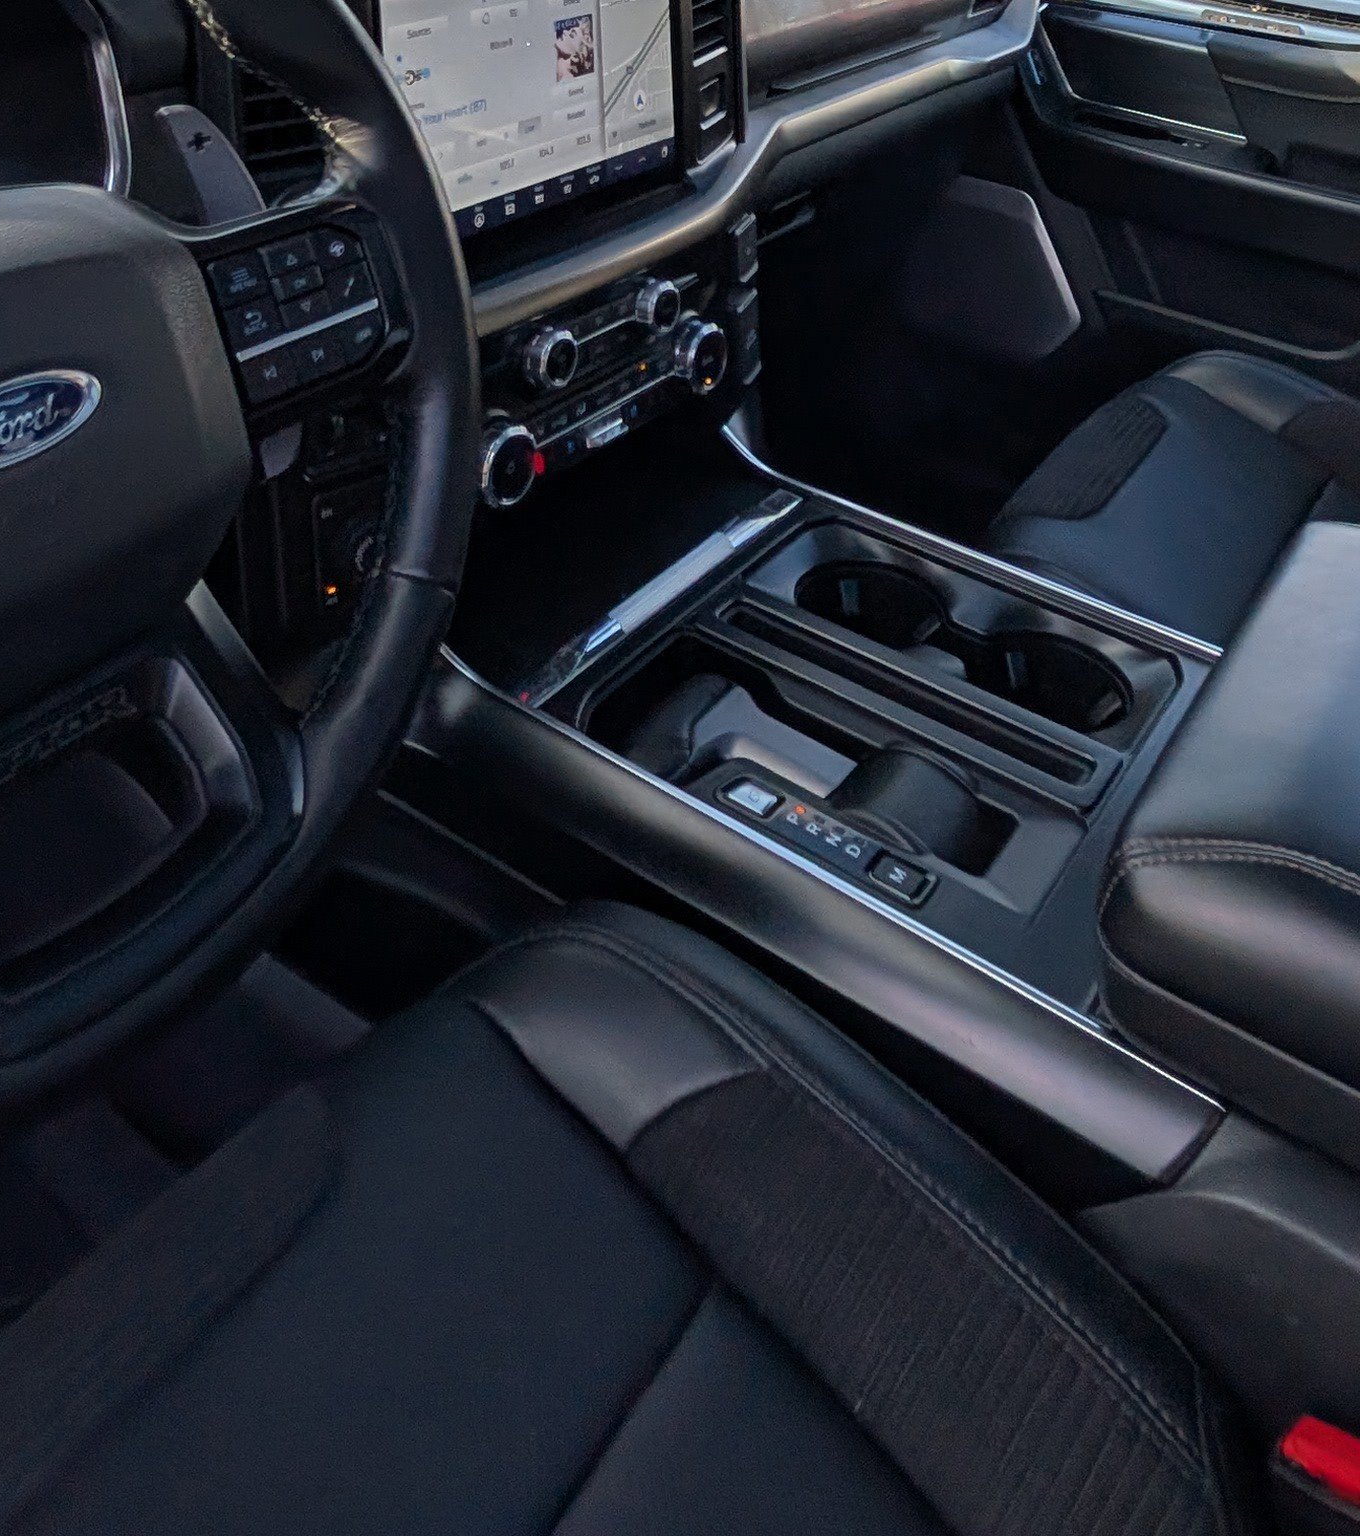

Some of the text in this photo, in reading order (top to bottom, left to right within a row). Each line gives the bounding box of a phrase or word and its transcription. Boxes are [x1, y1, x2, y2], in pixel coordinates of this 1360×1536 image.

[786, 811, 861, 859] P R N D
[889, 866, 907, 884] M
